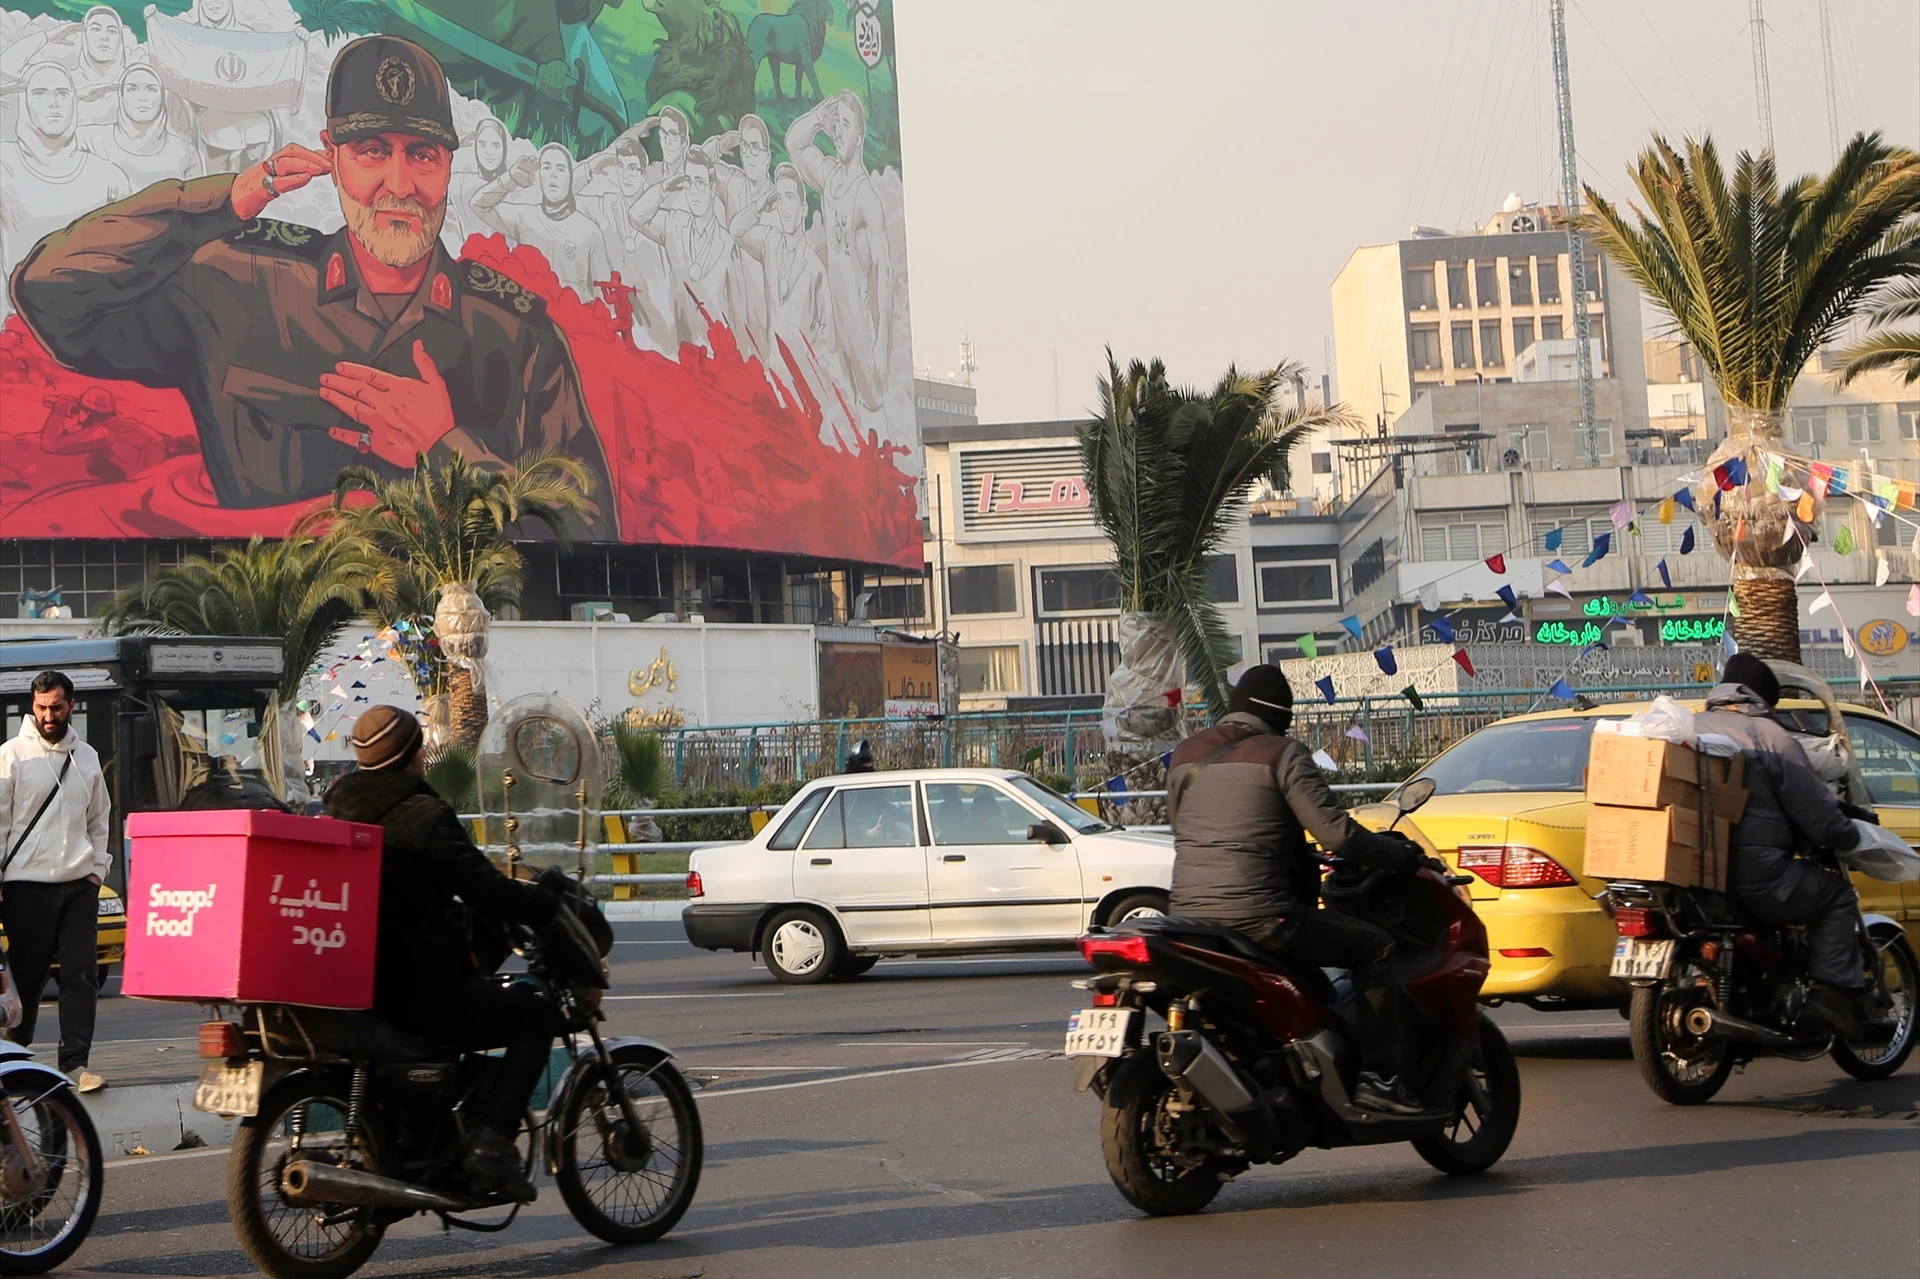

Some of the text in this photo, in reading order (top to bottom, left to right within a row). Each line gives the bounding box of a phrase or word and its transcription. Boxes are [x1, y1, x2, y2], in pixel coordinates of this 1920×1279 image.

[1421, 620, 1473, 645] خد
[1537, 621, 1602, 646] داروخانه
[628, 645, 678, 697] بالین
[148, 883, 217, 914] Snapp!
[146, 912, 194, 937] Food
[292, 922, 347, 955] فود
